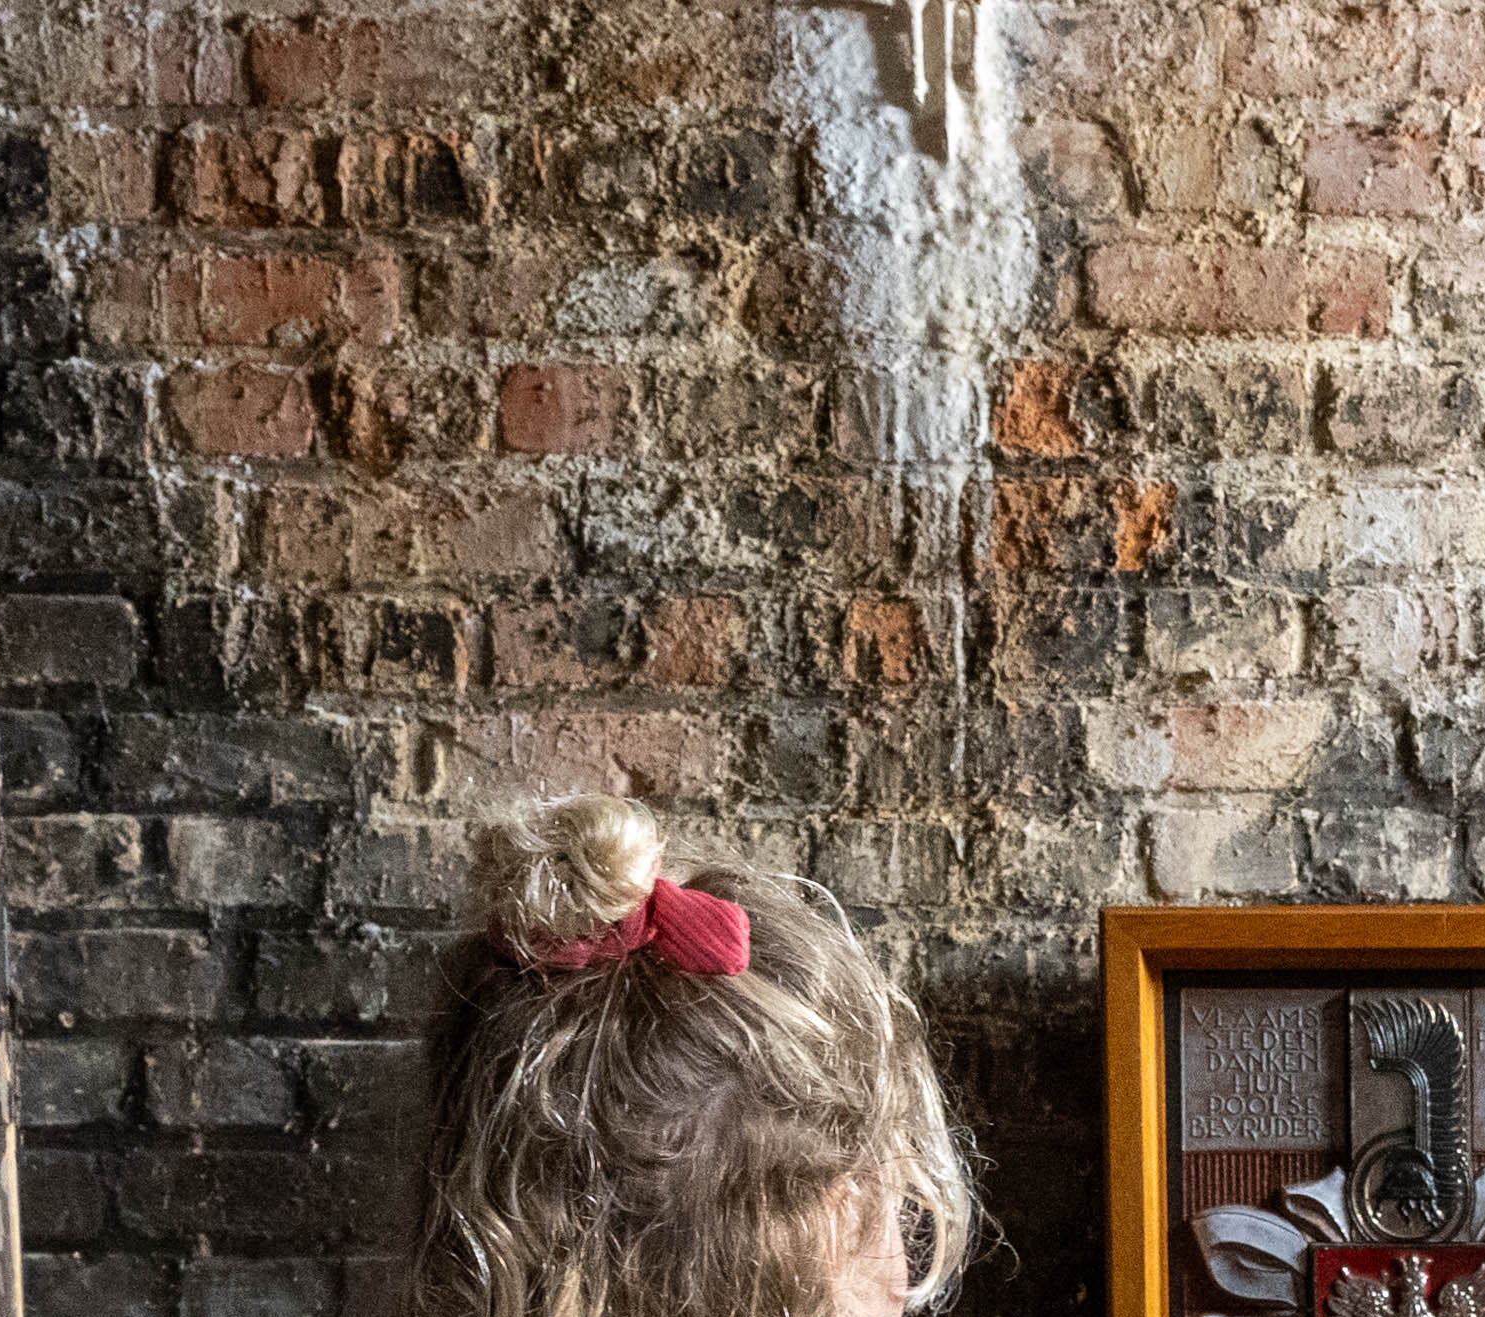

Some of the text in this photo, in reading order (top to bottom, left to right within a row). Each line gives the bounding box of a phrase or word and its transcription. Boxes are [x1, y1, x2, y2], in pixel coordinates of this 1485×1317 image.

[1205, 1030, 1321, 1051] STEDEN
[1207, 1051, 1322, 1073] DANKEN
[1234, 1074, 1296, 1095] HUN
[1207, 1094, 1320, 1115] POOLSE
